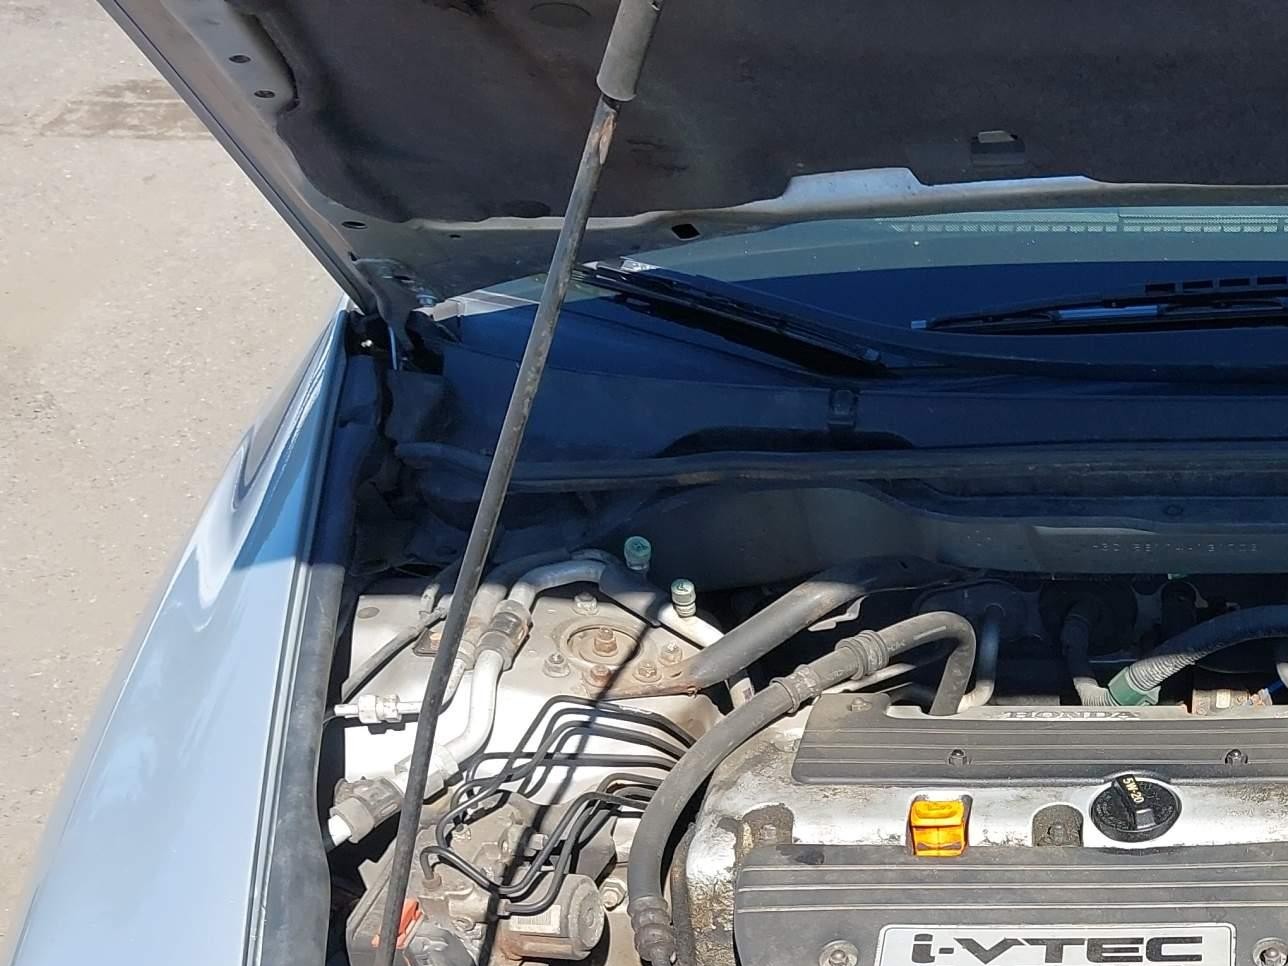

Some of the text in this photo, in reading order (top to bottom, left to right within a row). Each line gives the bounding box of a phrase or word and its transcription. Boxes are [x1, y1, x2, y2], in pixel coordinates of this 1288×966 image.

[1002, 710, 1140, 719] HONDA
[1122, 777, 1145, 803] 5W-20
[911, 933, 1203, 964] i-VTEC
